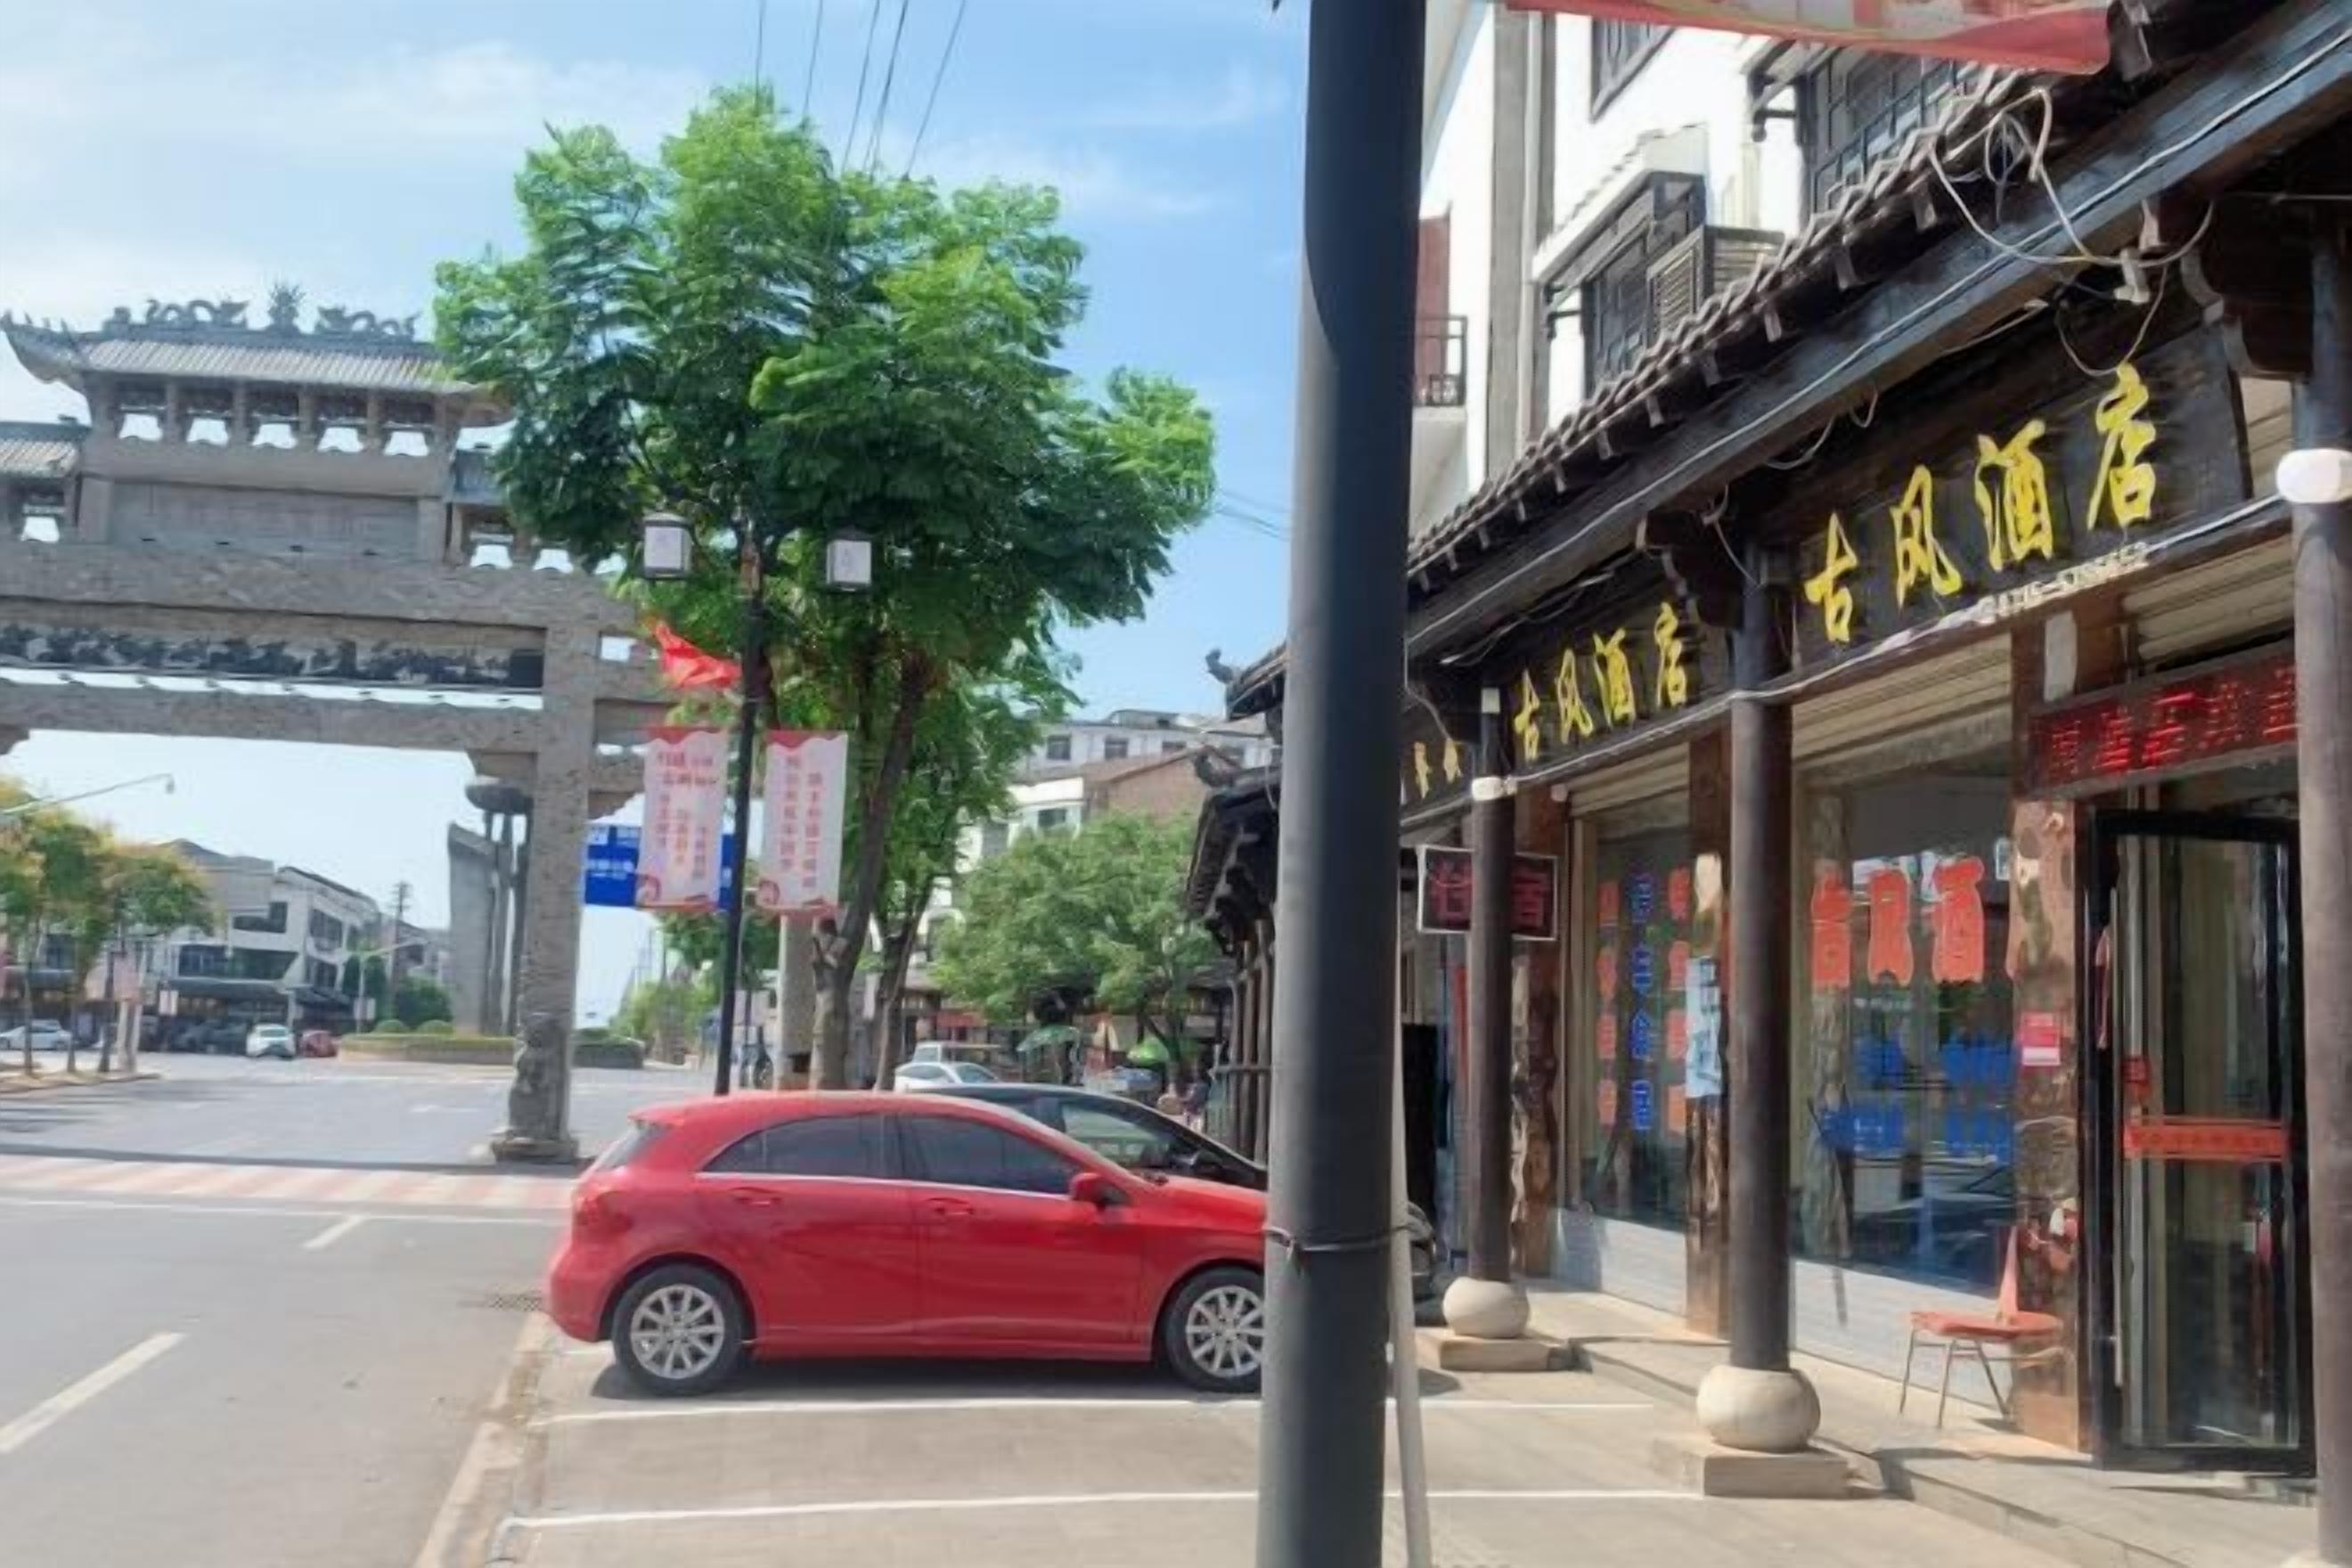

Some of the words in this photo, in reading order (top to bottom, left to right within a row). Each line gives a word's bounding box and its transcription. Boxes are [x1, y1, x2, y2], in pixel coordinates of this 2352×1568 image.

[1804, 362, 2157, 643] 古风酒店
[1514, 601, 1688, 763] 古风酒店
